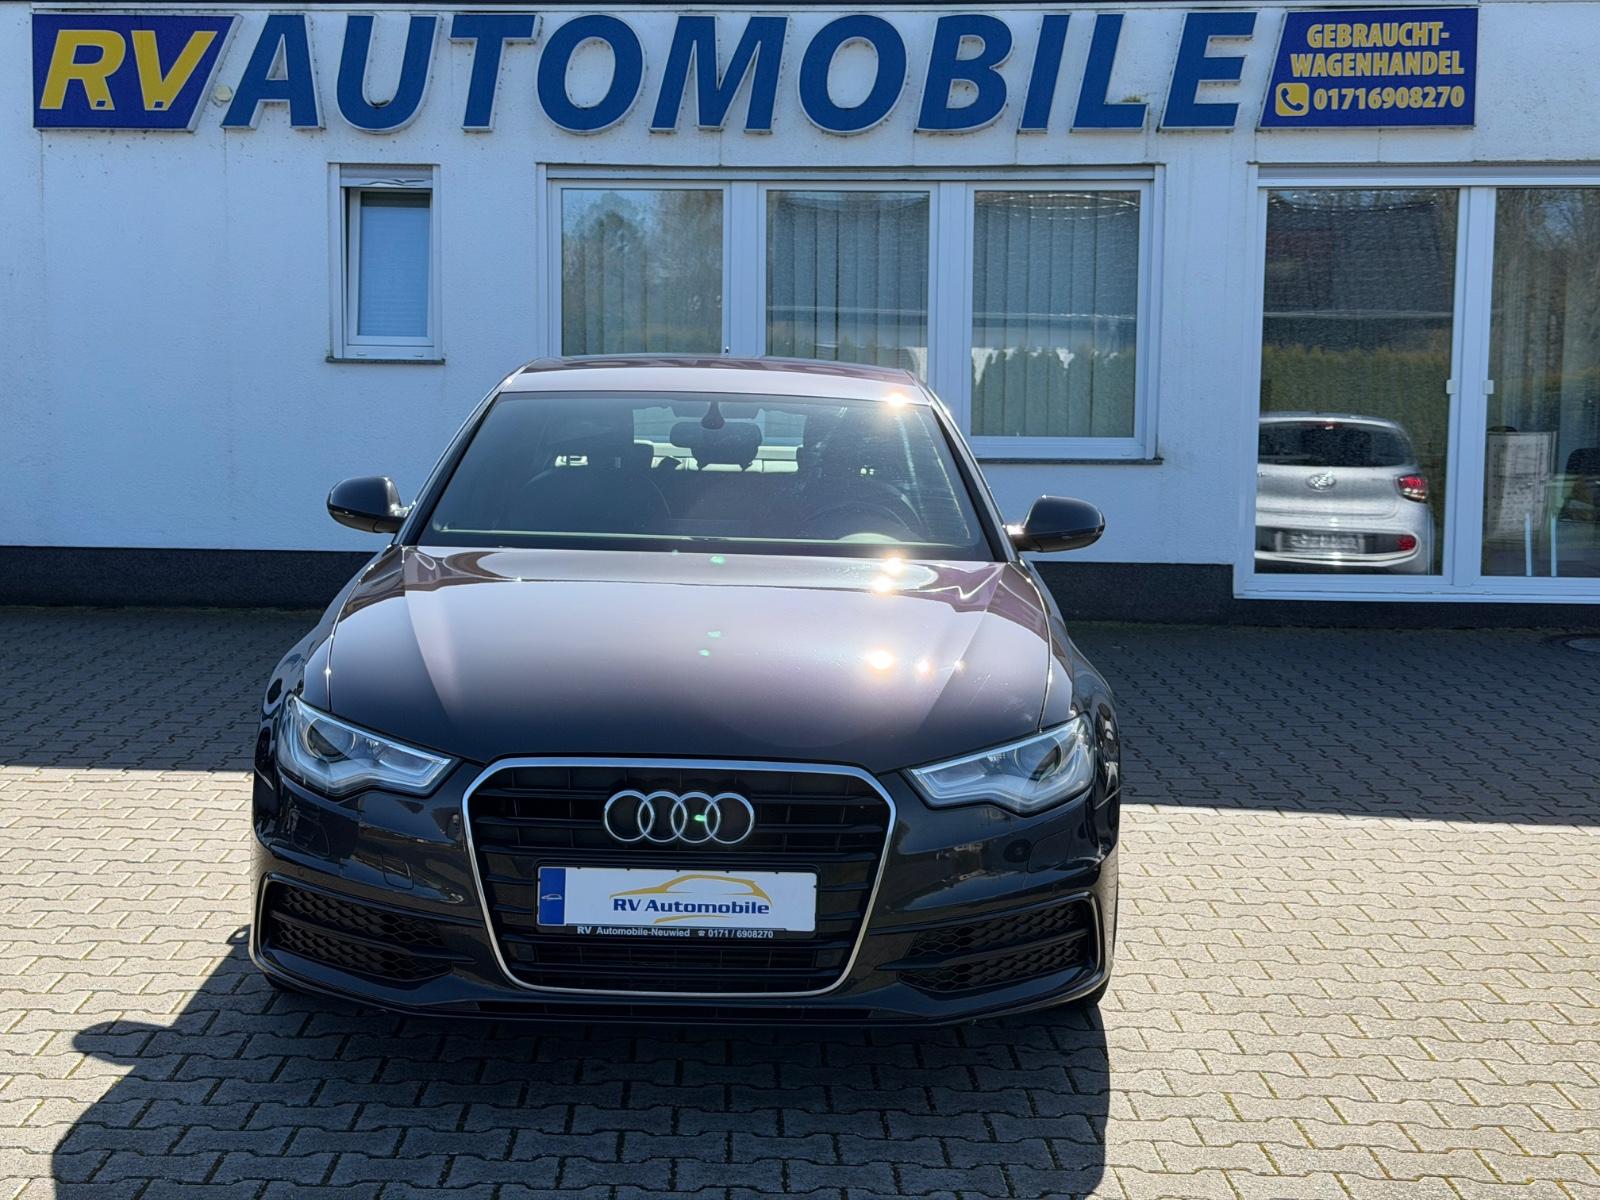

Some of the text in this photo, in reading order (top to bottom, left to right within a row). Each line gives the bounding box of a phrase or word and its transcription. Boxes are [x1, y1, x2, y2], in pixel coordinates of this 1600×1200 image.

[1306, 21, 1450, 49] GEBRAUCHT-
[222, 11, 1258, 134] AUTOMOBILE
[1290, 50, 1465, 78] WAGENHANDEL
[1313, 85, 1465, 111] 01716908270
[613, 898, 770, 915] RV Automobile
[576, 926, 592, 935] RV
[596, 927, 690, 938] Automobile-Neuwied
[707, 930, 729, 939] 0171
[736, 930, 774, 939] 6908270
